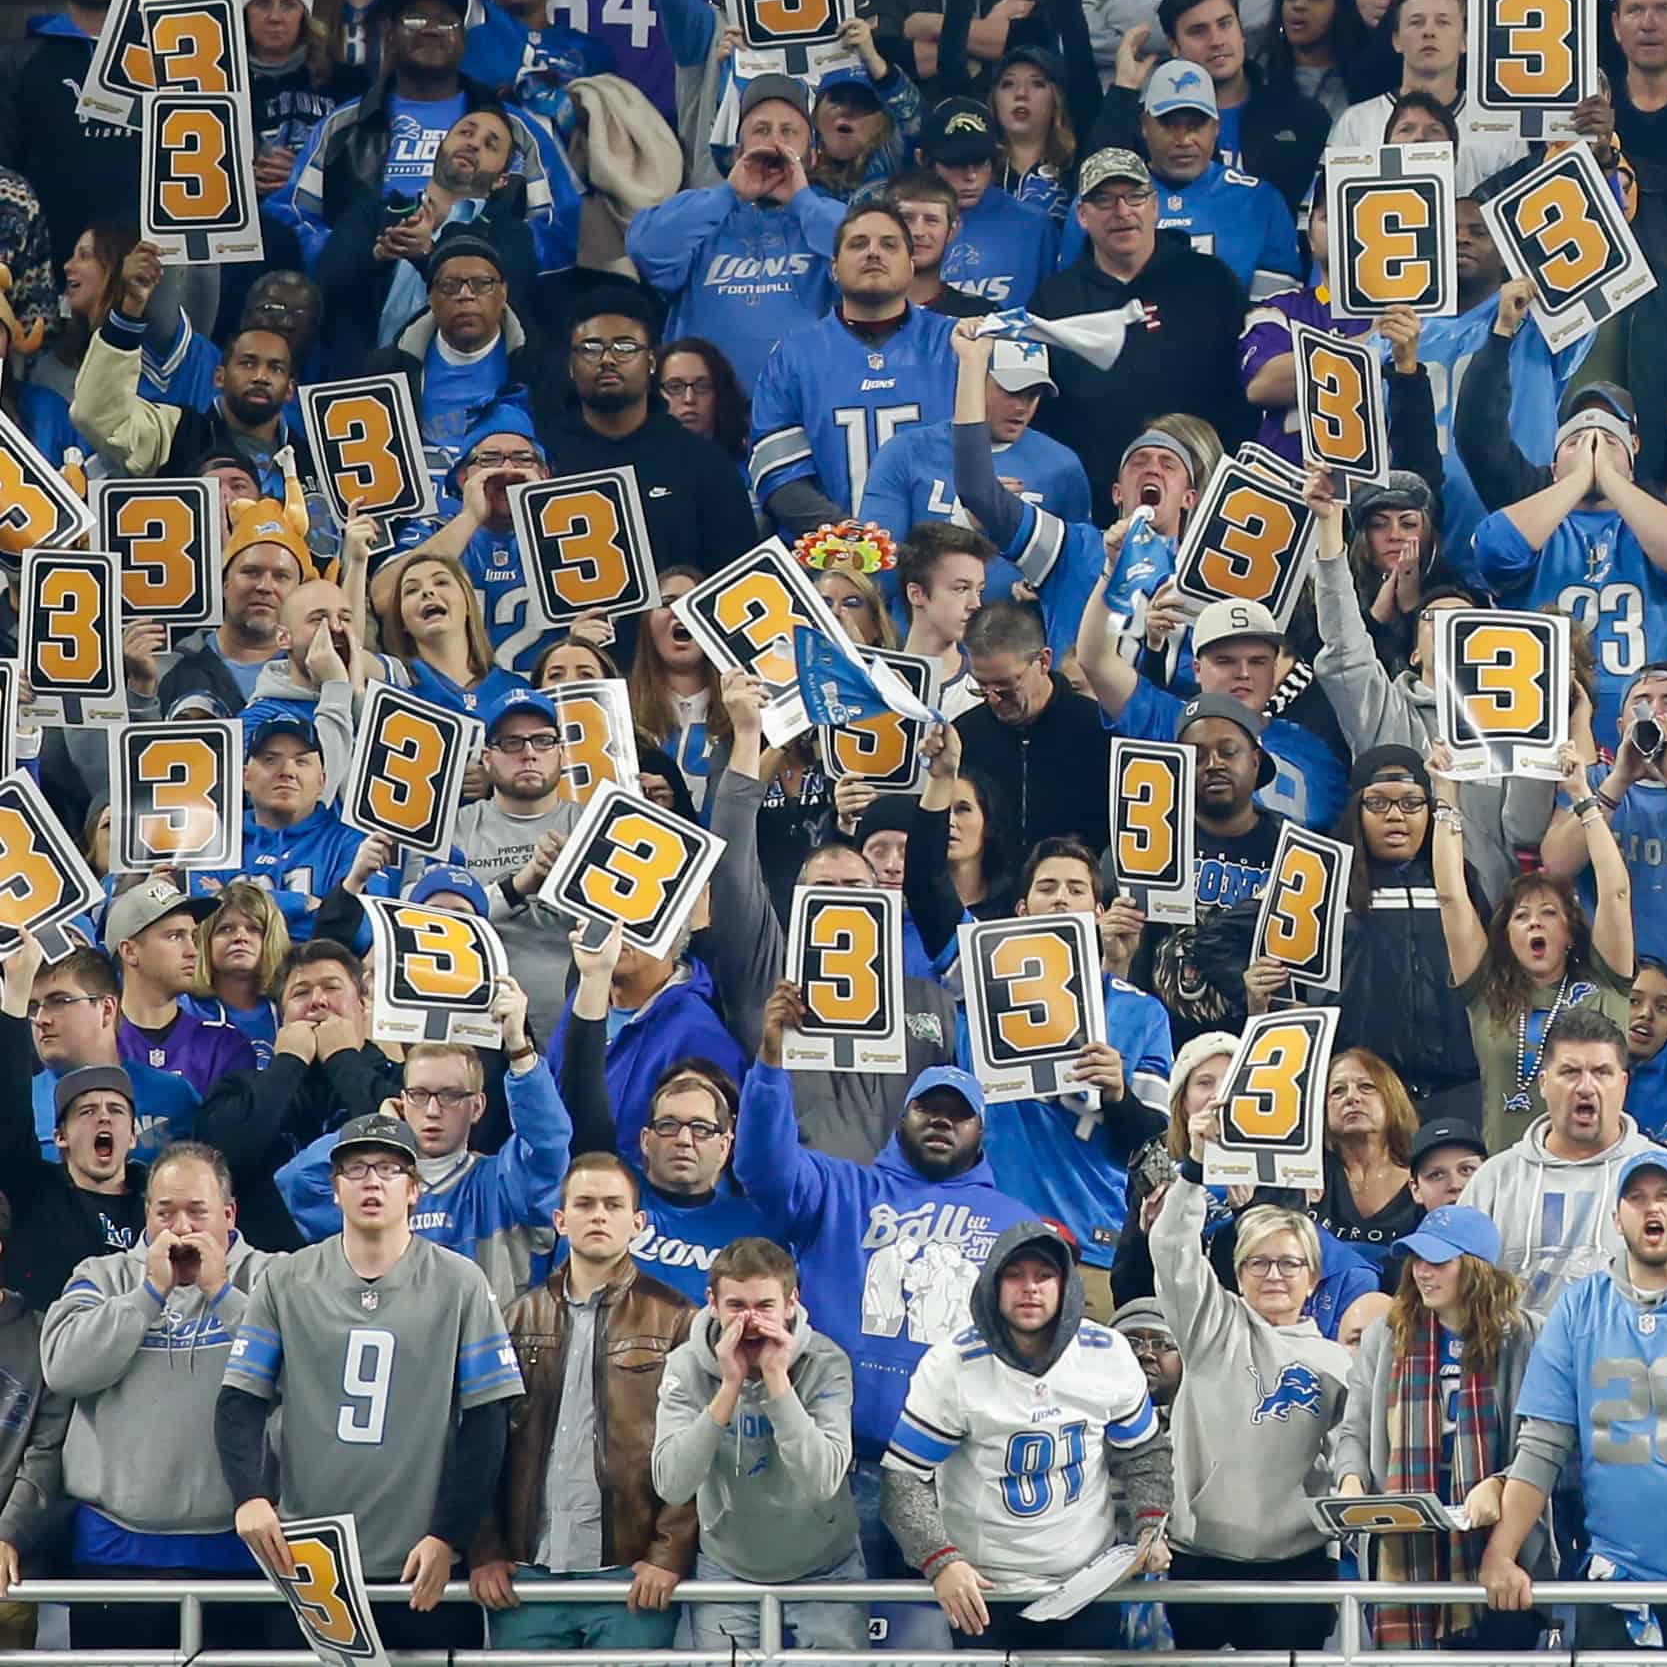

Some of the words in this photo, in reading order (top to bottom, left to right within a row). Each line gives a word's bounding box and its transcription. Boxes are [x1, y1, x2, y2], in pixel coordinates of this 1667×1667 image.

[160, 111, 231, 220] 3
[396, 140, 440, 162] LIO
[703, 252, 815, 286] LIONS
[1354, 191, 1430, 301] 3
[1516, 177, 1609, 291] 3
[717, 282, 792, 296] FOOTBALL
[860, 376, 898, 391] LIONS
[1310, 349, 1366, 461] 3
[324, 397, 404, 512] 3
[117, 497, 195, 609] 3
[541, 491, 628, 606] 3
[1199, 489, 1296, 602] 3
[38, 569, 102, 683] 3
[1230, 606, 1249, 629] S
[1465, 628, 1543, 731] 3
[140, 739, 216, 855] 3
[368, 711, 445, 831] 3
[1118, 760, 1174, 874] 3
[467, 856, 519, 870] PONTIAC
[498, 843, 535, 856] PROPE
[583, 816, 686, 923] 3
[397, 909, 483, 997] 3
[1265, 848, 1327, 964] 3
[809, 907, 879, 1023] 3
[994, 934, 1078, 1051] 3
[1231, 1027, 1308, 1138] 3
[628, 1226, 723, 1269] LION
[861, 1201, 970, 1249] Ball
[1306, 1209, 1398, 1244] DETRO
[336, 1328, 397, 1446] 9
[1030, 1406, 1063, 1424] LIONS
[1000, 1420, 1089, 1518] 81
